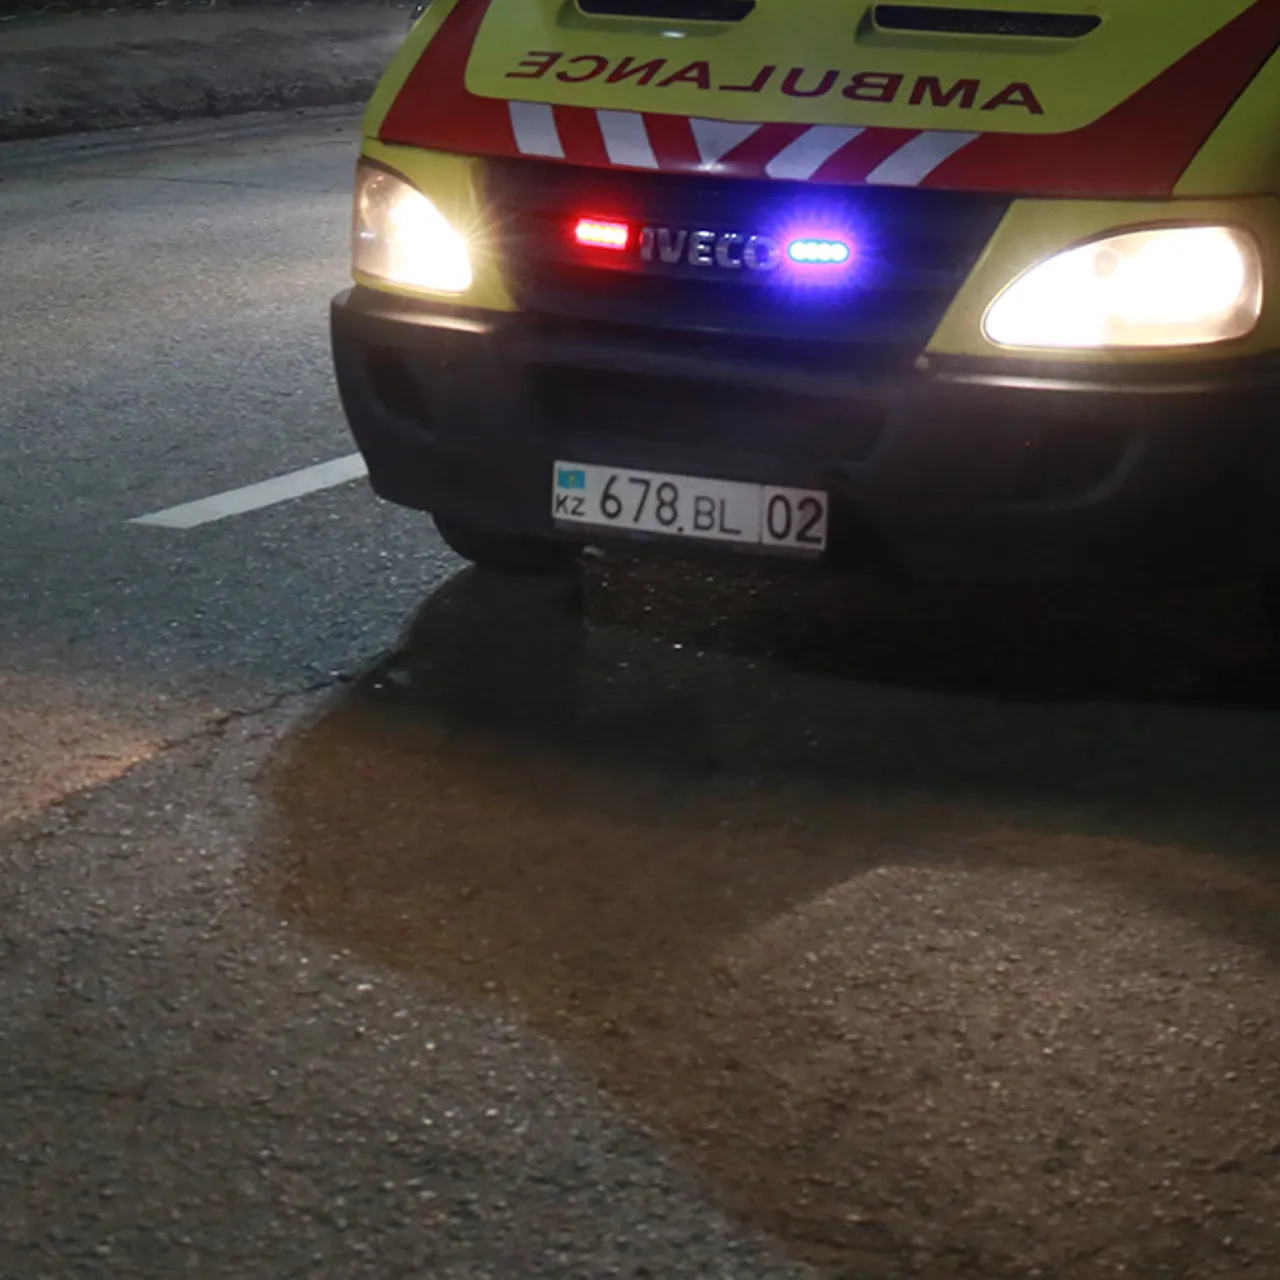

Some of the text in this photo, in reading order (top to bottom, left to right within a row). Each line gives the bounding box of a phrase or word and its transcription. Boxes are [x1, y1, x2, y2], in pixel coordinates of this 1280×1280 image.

[640, 226, 780, 270] IVECO
[555, 475, 824, 544] KZ 678 BL 02
